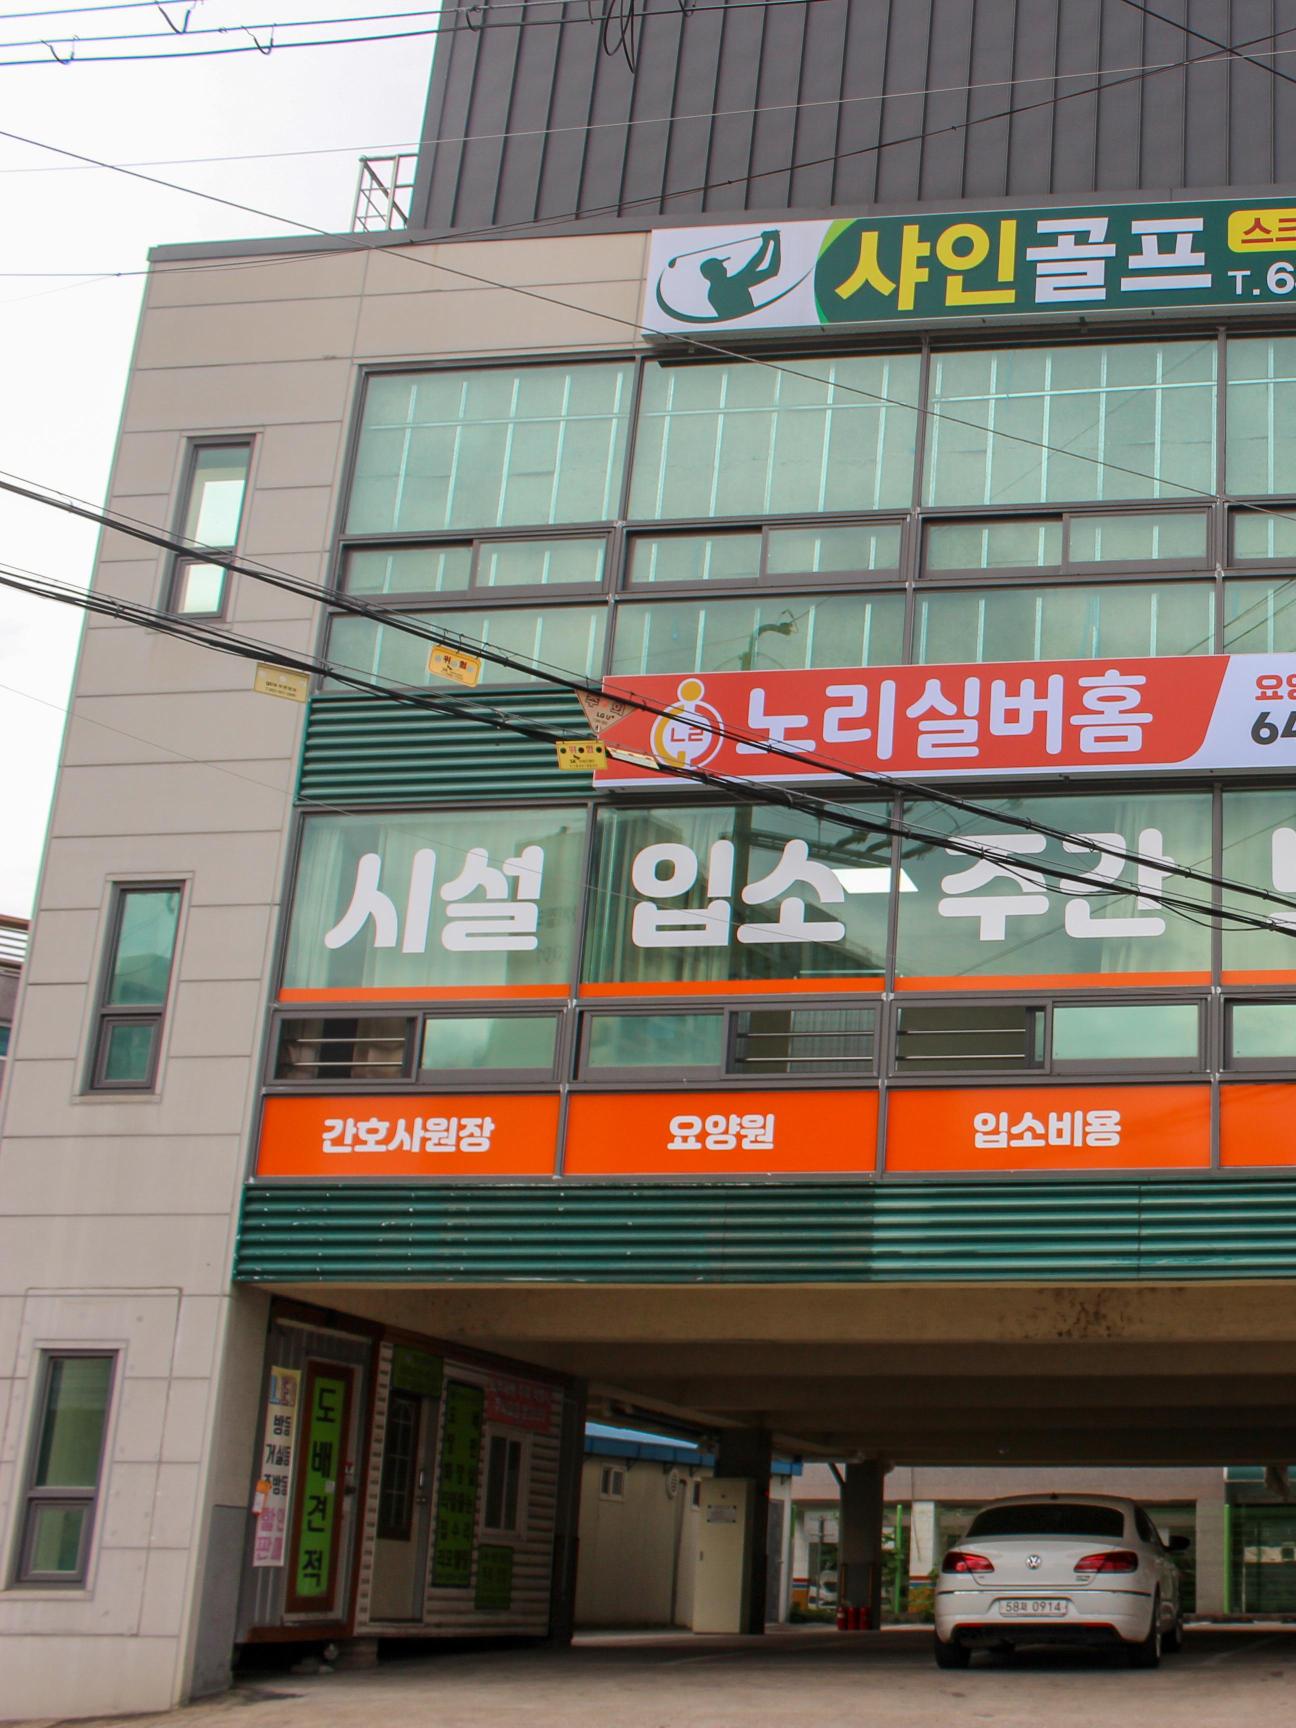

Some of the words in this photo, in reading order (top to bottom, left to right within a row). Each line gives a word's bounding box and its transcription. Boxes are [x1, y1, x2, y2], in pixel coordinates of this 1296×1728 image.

[834, 217, 1212, 311] 샤인골프
[737, 669, 1155, 762] 노리실버홈
[324, 845, 544, 954] 시설
[631, 838, 846, 948] 입소
[937, 828, 1174, 941] 주간
[322, 1116, 495, 1154] 간호사원장
[667, 1114, 776, 1152] 요양원
[973, 1111, 1122, 1149] 입소비용
[1032, 1602, 1061, 1612] 0914
